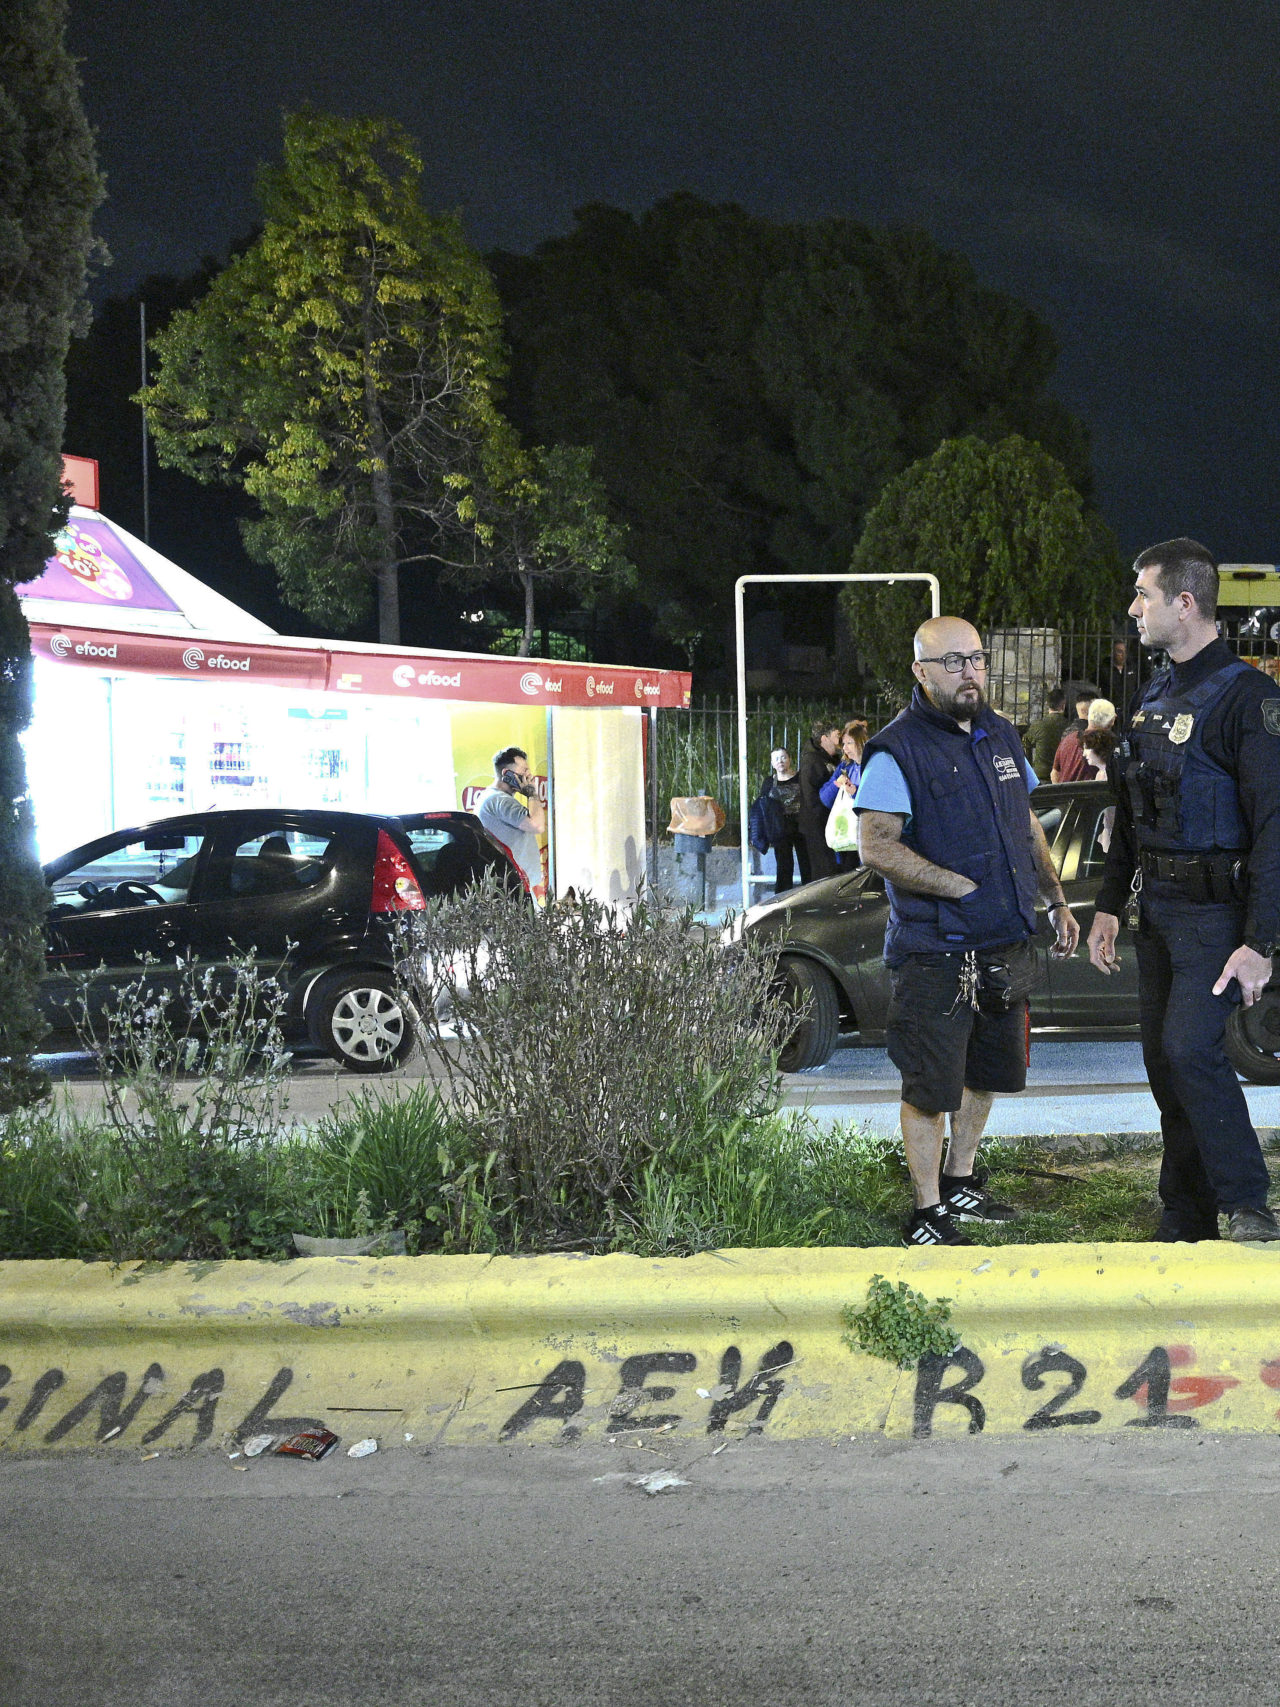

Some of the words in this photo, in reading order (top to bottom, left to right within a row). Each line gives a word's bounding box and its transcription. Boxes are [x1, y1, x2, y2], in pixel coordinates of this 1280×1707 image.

[75, 641, 117, 658] efood
[207, 654, 250, 671] efood
[418, 670, 462, 687] efood
[595, 681, 614, 695] efood
[0, 1362, 325, 1446] INAL
